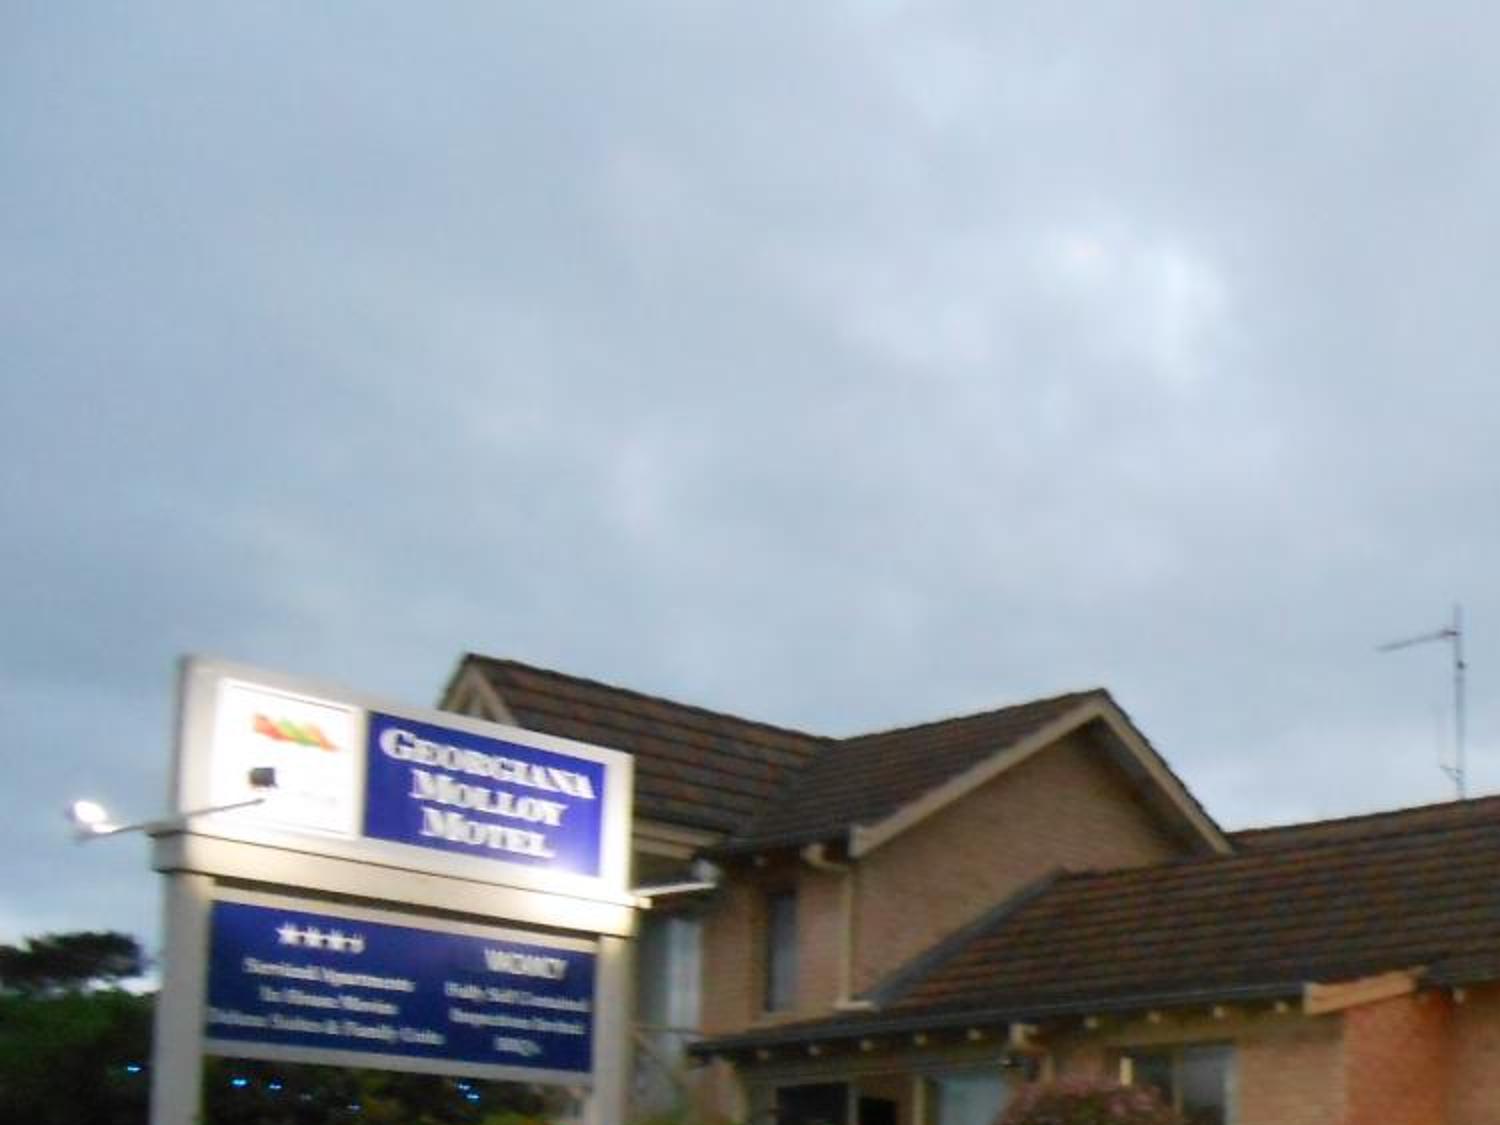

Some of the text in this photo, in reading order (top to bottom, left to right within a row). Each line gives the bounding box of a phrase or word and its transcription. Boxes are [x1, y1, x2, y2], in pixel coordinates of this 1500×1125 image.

[379, 728, 597, 799] GEORGIANA
[408, 768, 569, 827] MOLLOY
[418, 805, 557, 858] MOTEL
